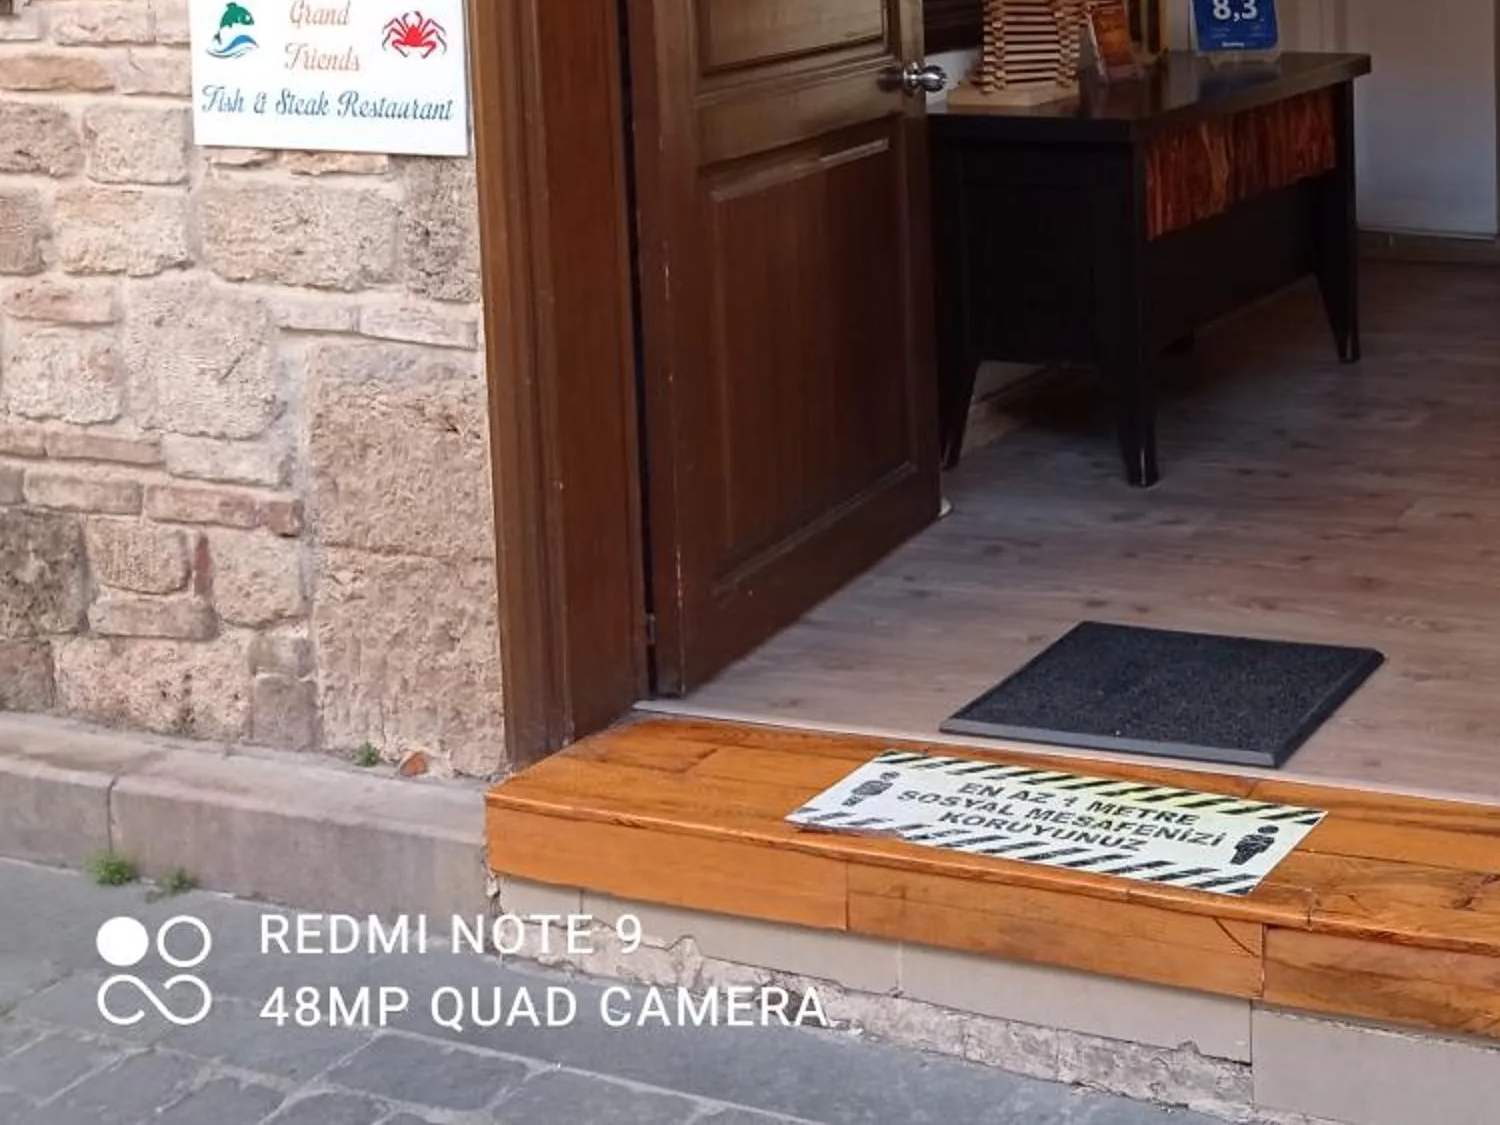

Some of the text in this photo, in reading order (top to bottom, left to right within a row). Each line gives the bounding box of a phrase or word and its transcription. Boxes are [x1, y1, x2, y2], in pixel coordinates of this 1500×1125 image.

[284, 42, 361, 72] Friends
[201, 85, 455, 121] Fish & Steak Restaurant
[897, 789, 1227, 847] SOSYAL MESAFENİZİ
[958, 782, 1004, 798] EN
[1014, 789, 1057, 805] AZ
[1086, 801, 1201, 826] METRE
[937, 811, 1149, 852] KORUYUNUZ
